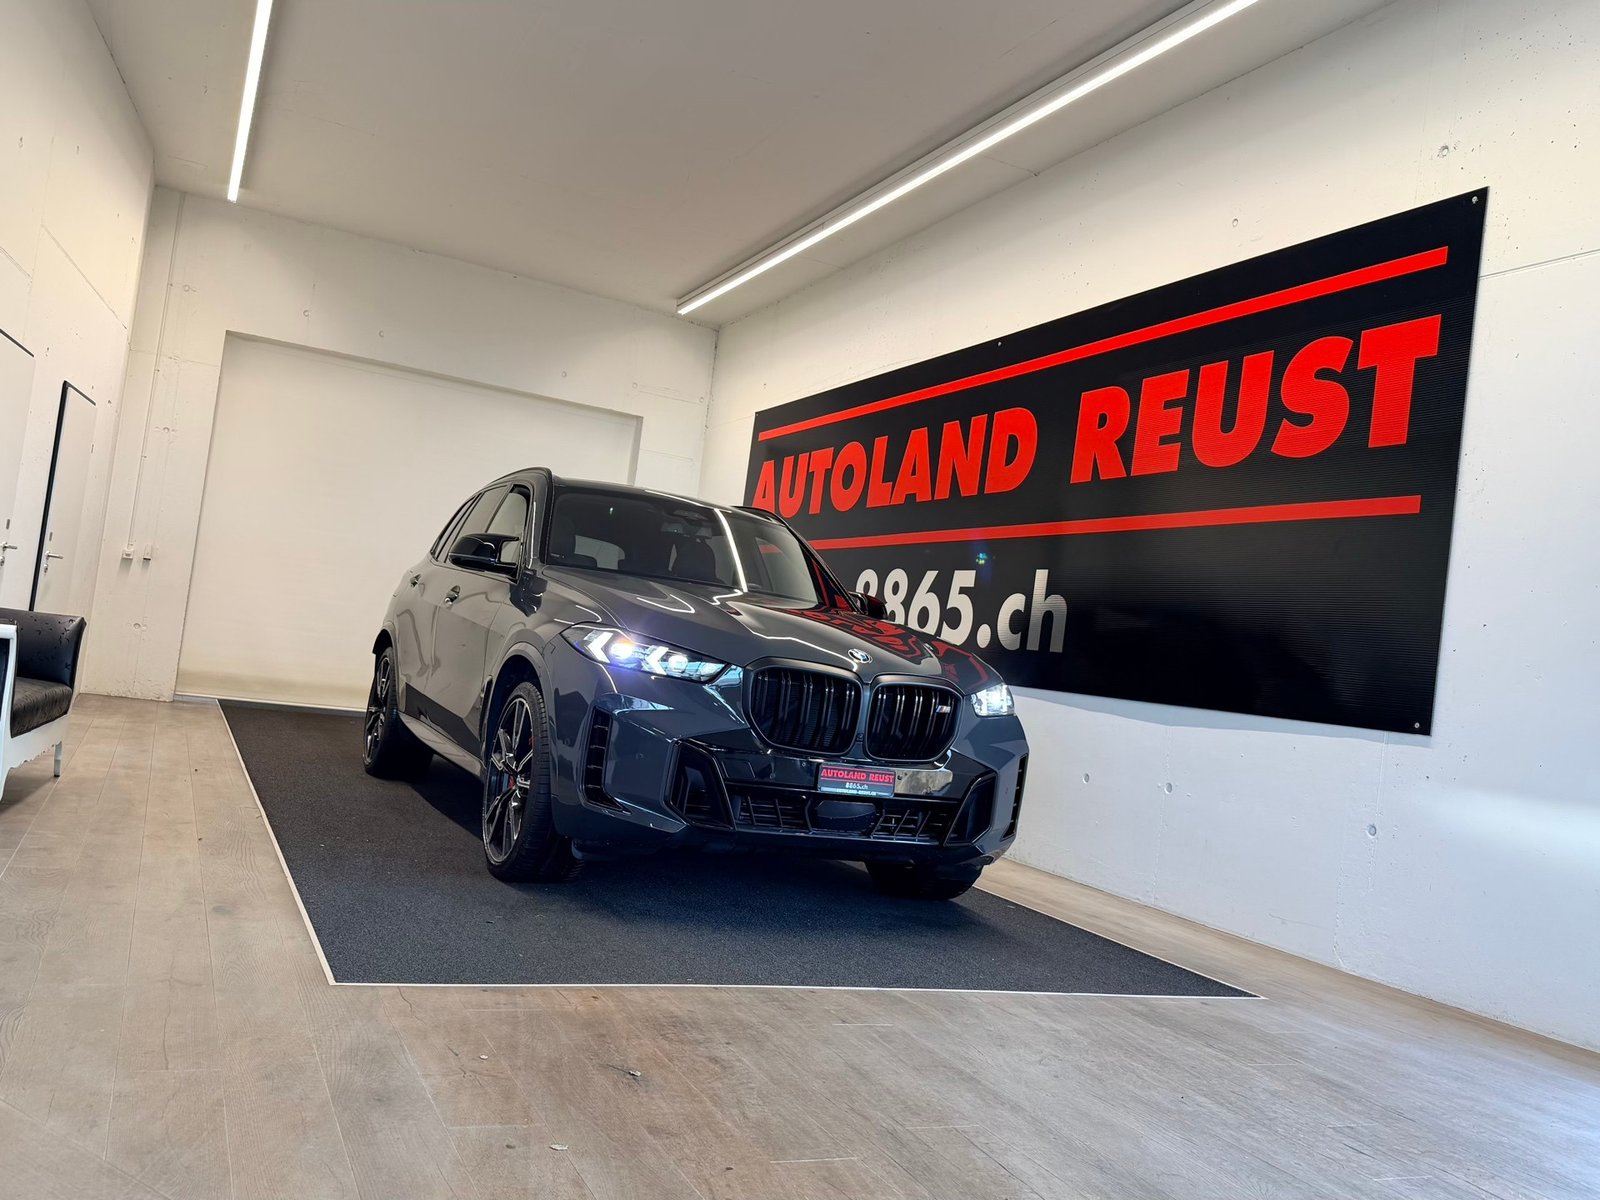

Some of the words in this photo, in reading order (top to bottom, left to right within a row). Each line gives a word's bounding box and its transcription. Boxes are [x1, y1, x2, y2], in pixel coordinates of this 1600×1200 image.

[752, 407, 1038, 518] AUTOLAND
[1069, 314, 1442, 483] REUST
[820, 769, 867, 781] AUTOLAND
[868, 773, 895, 783] REUST
